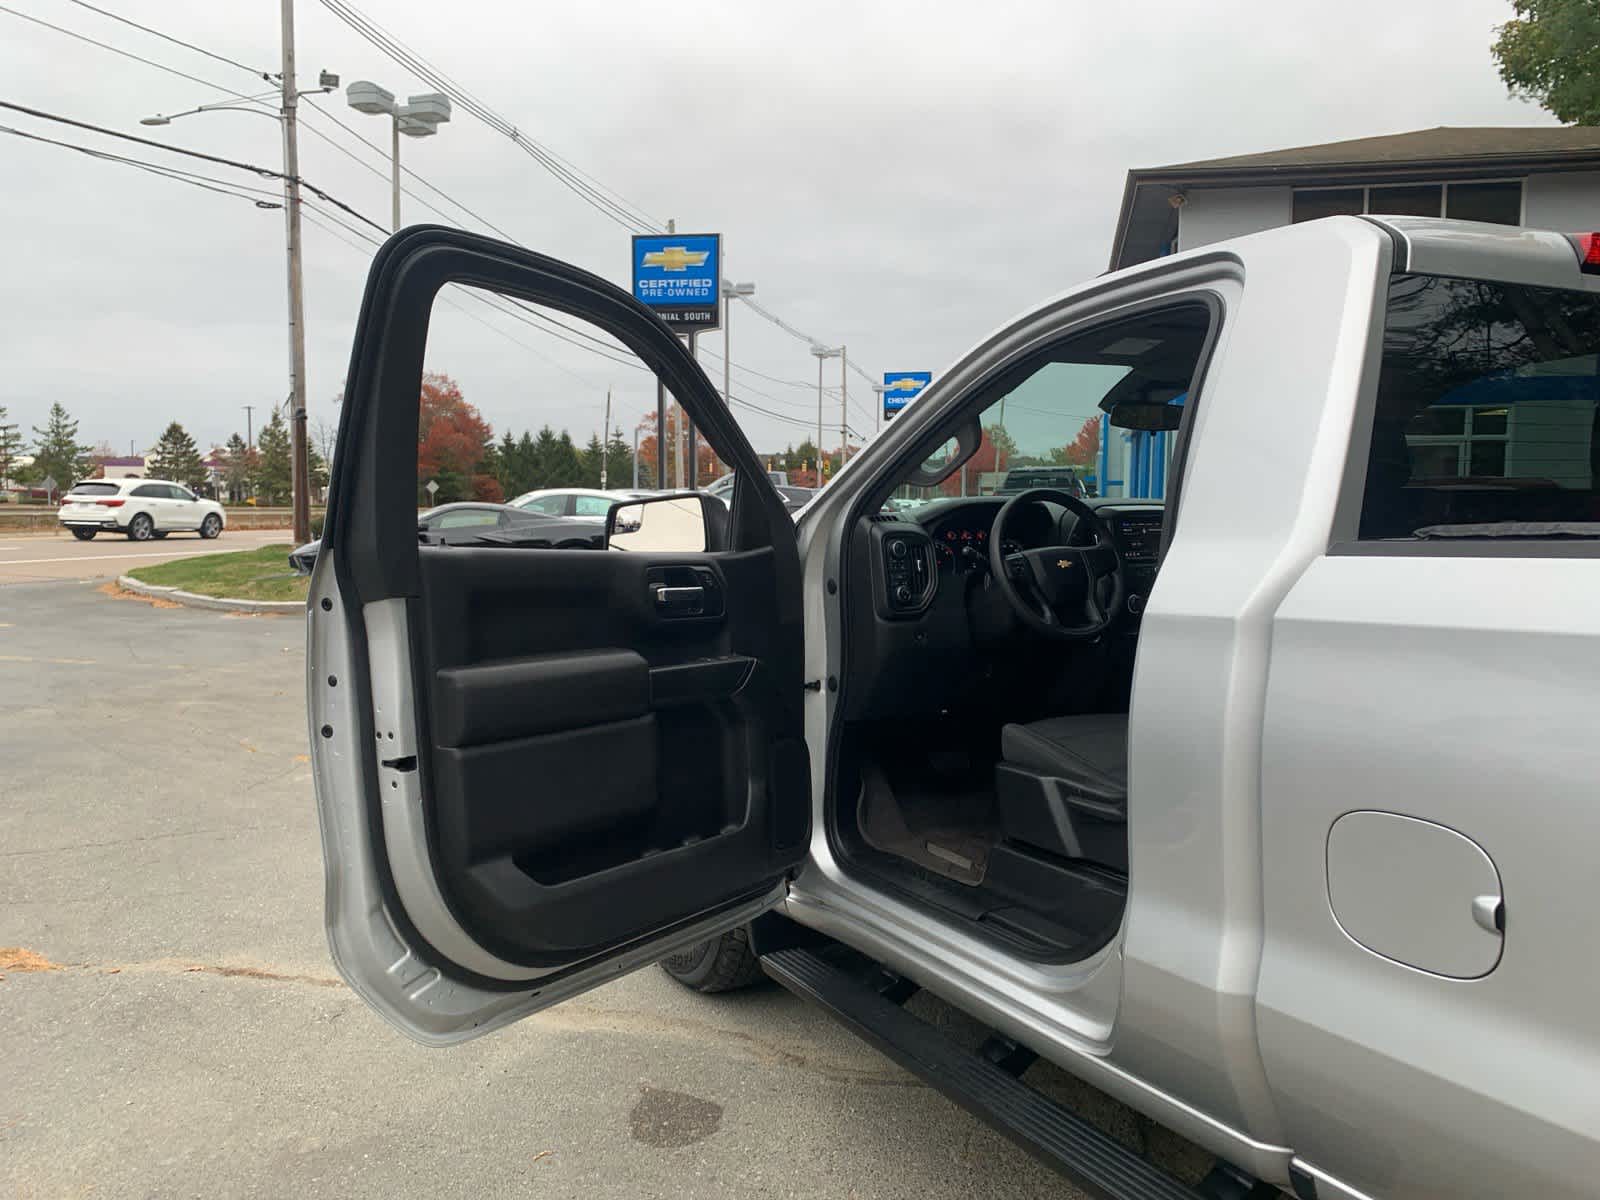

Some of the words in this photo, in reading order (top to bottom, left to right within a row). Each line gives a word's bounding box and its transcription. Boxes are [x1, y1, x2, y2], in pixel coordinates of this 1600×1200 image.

[639, 279, 712, 288] CERTIFIED
[642, 288, 709, 296] PRE-OWNED
[684, 312, 710, 320] SOUTH
